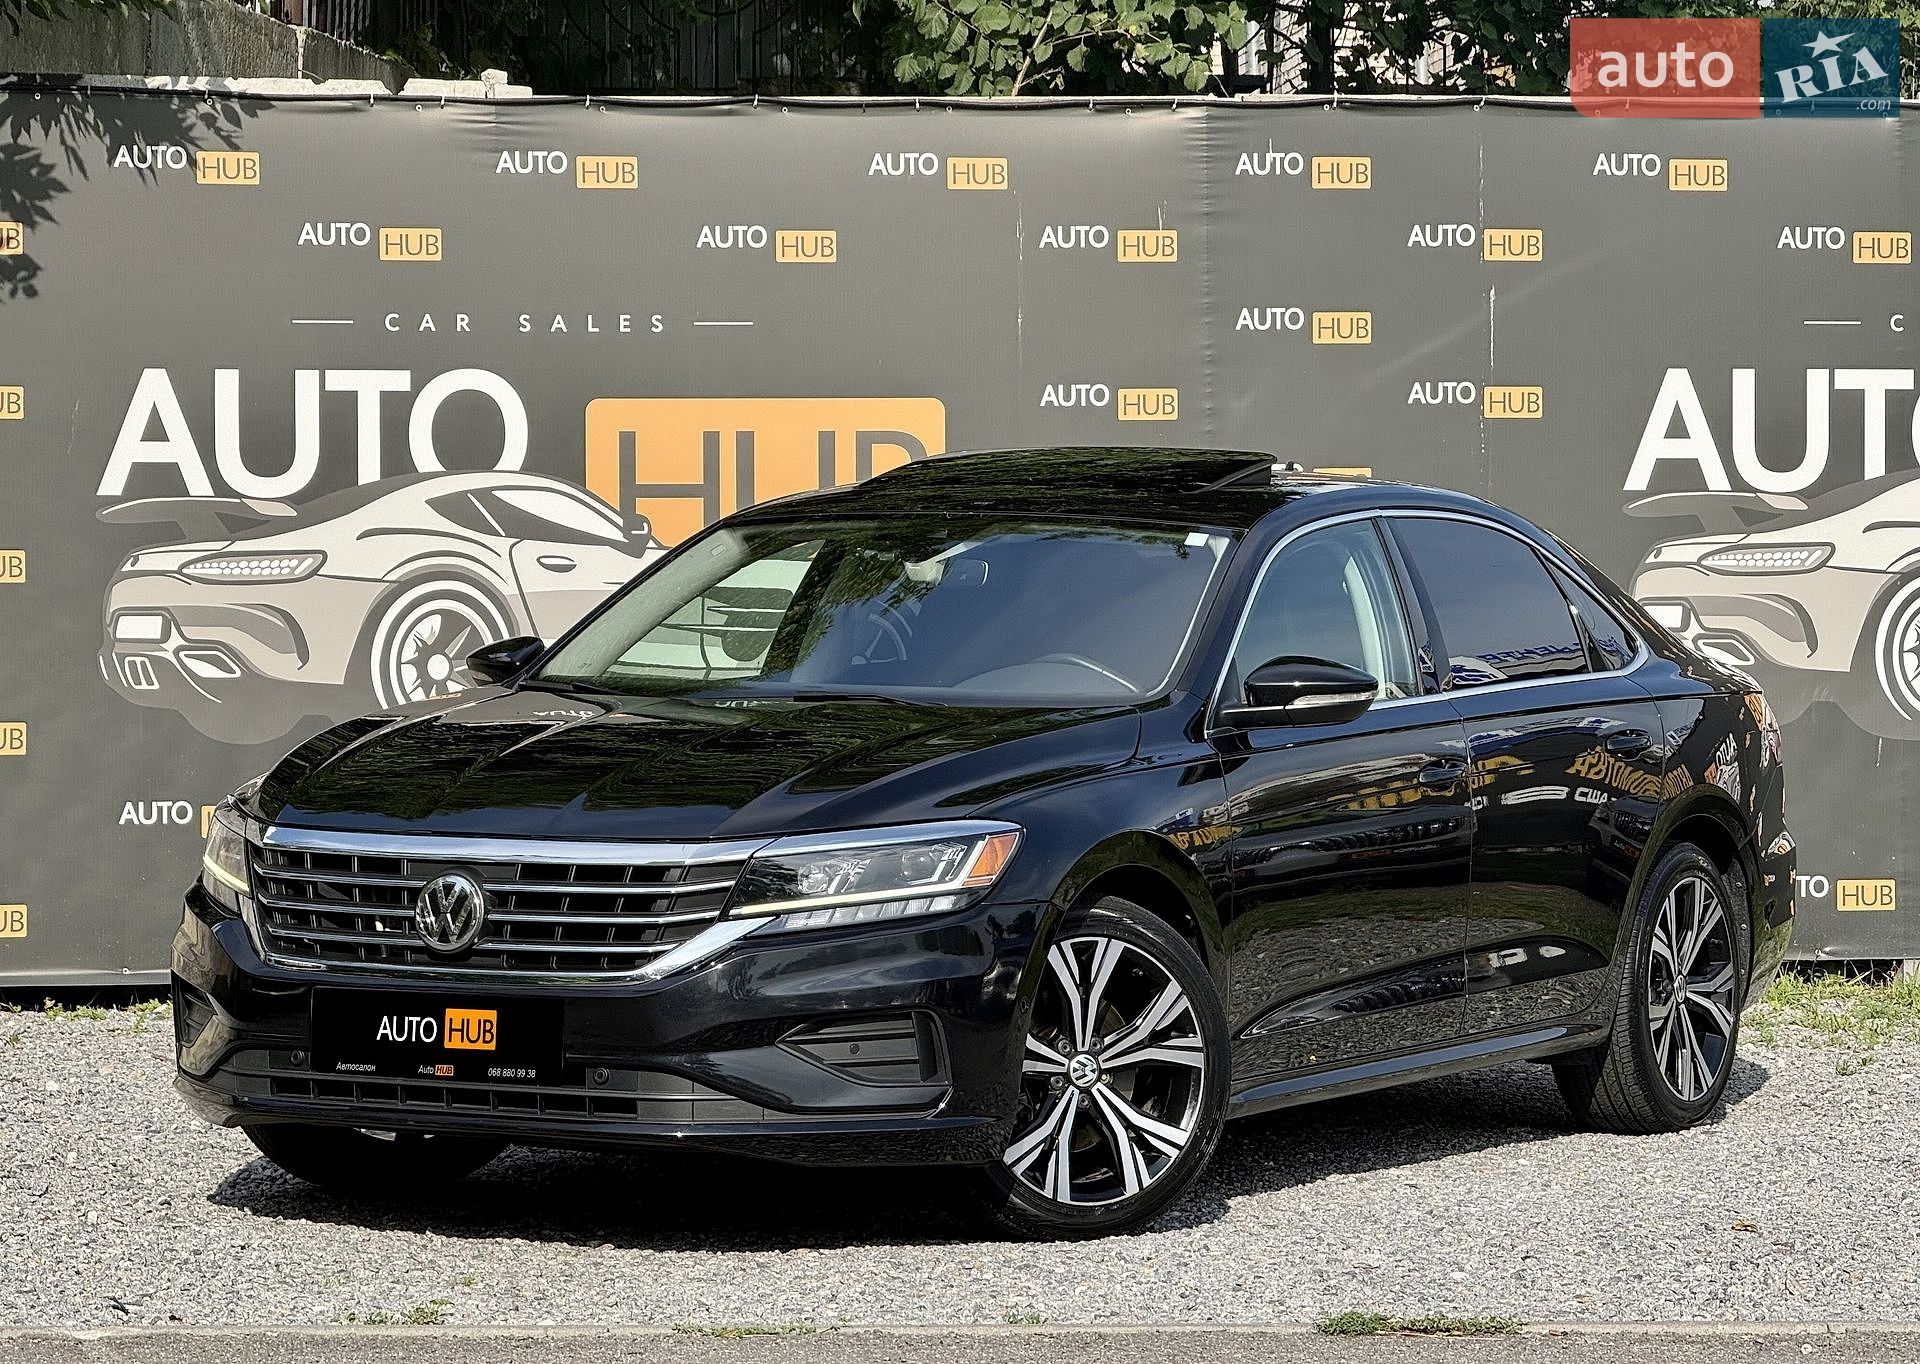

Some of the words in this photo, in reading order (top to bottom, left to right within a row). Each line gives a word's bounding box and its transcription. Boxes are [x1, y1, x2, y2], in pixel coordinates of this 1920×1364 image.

[114, 145, 186, 169] AUTO
[201, 157, 256, 180] HUB
[496, 151, 567, 174] AUTO
[582, 162, 635, 183] HUB
[869, 153, 938, 175] AUTO
[953, 164, 1004, 184] HUB
[1235, 153, 1303, 175] AUTO
[1318, 163, 1368, 183] HUB
[1593, 153, 1661, 176] AUTO
[1674, 165, 1724, 186] HUB
[298, 223, 370, 246] AUTO
[386, 234, 438, 255] HUB
[697, 225, 767, 248] AUTO
[782, 236, 833, 257] HUB
[1039, 225, 1109, 248] AUTO
[1123, 236, 1173, 257] HUB
[1408, 224, 1475, 247] AUTO
[1490, 235, 1539, 256] HUB
[1777, 227, 1845, 249] AUTO
[1859, 238, 1908, 258] HUB
[385, 314, 470, 331] CAR
[519, 315, 665, 332] SALES
[1236, 308, 1304, 330] AUTO
[1318, 318, 1368, 338] HUB
[1040, 384, 1109, 406] AUTO
[1124, 394, 1174, 415] HUB
[1408, 382, 1475, 404] AUTO
[1490, 392, 1539, 413] HUB
[96, 368, 528, 498] AUTO
[1623, 368, 1920, 493] AUT
[119, 801, 192, 824] AUTO
[1842, 885, 1893, 906] HUB
[376, 1016, 437, 1042] AUTO
[449, 1018, 495, 1044] HUB
[418, 1065, 434, 1075] Auto
[436, 1066, 453, 1075] HUB
[516, 1068, 525, 1078] 99
[526, 1069, 536, 1078] 38
